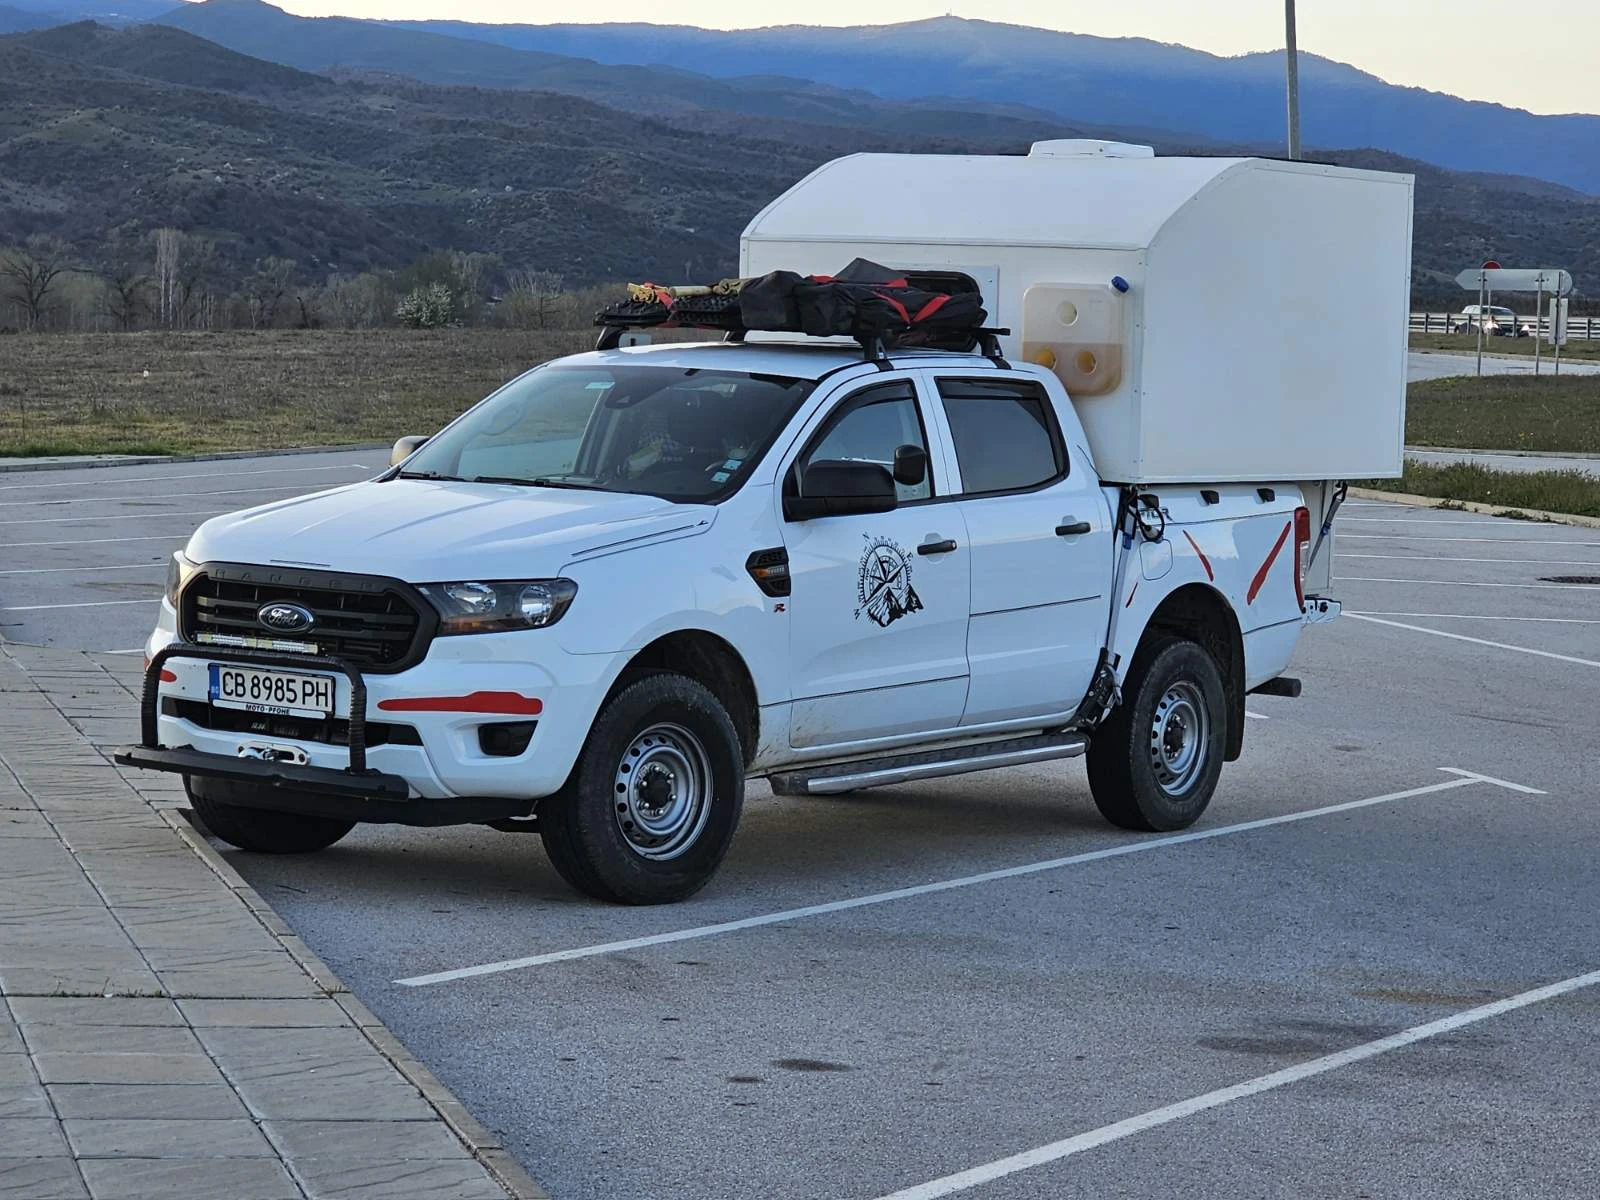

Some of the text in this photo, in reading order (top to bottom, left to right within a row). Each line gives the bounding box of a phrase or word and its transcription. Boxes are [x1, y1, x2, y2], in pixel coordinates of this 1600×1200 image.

[268, 607, 298, 627] Ford
[222, 671, 329, 708] CB 8985 PH
